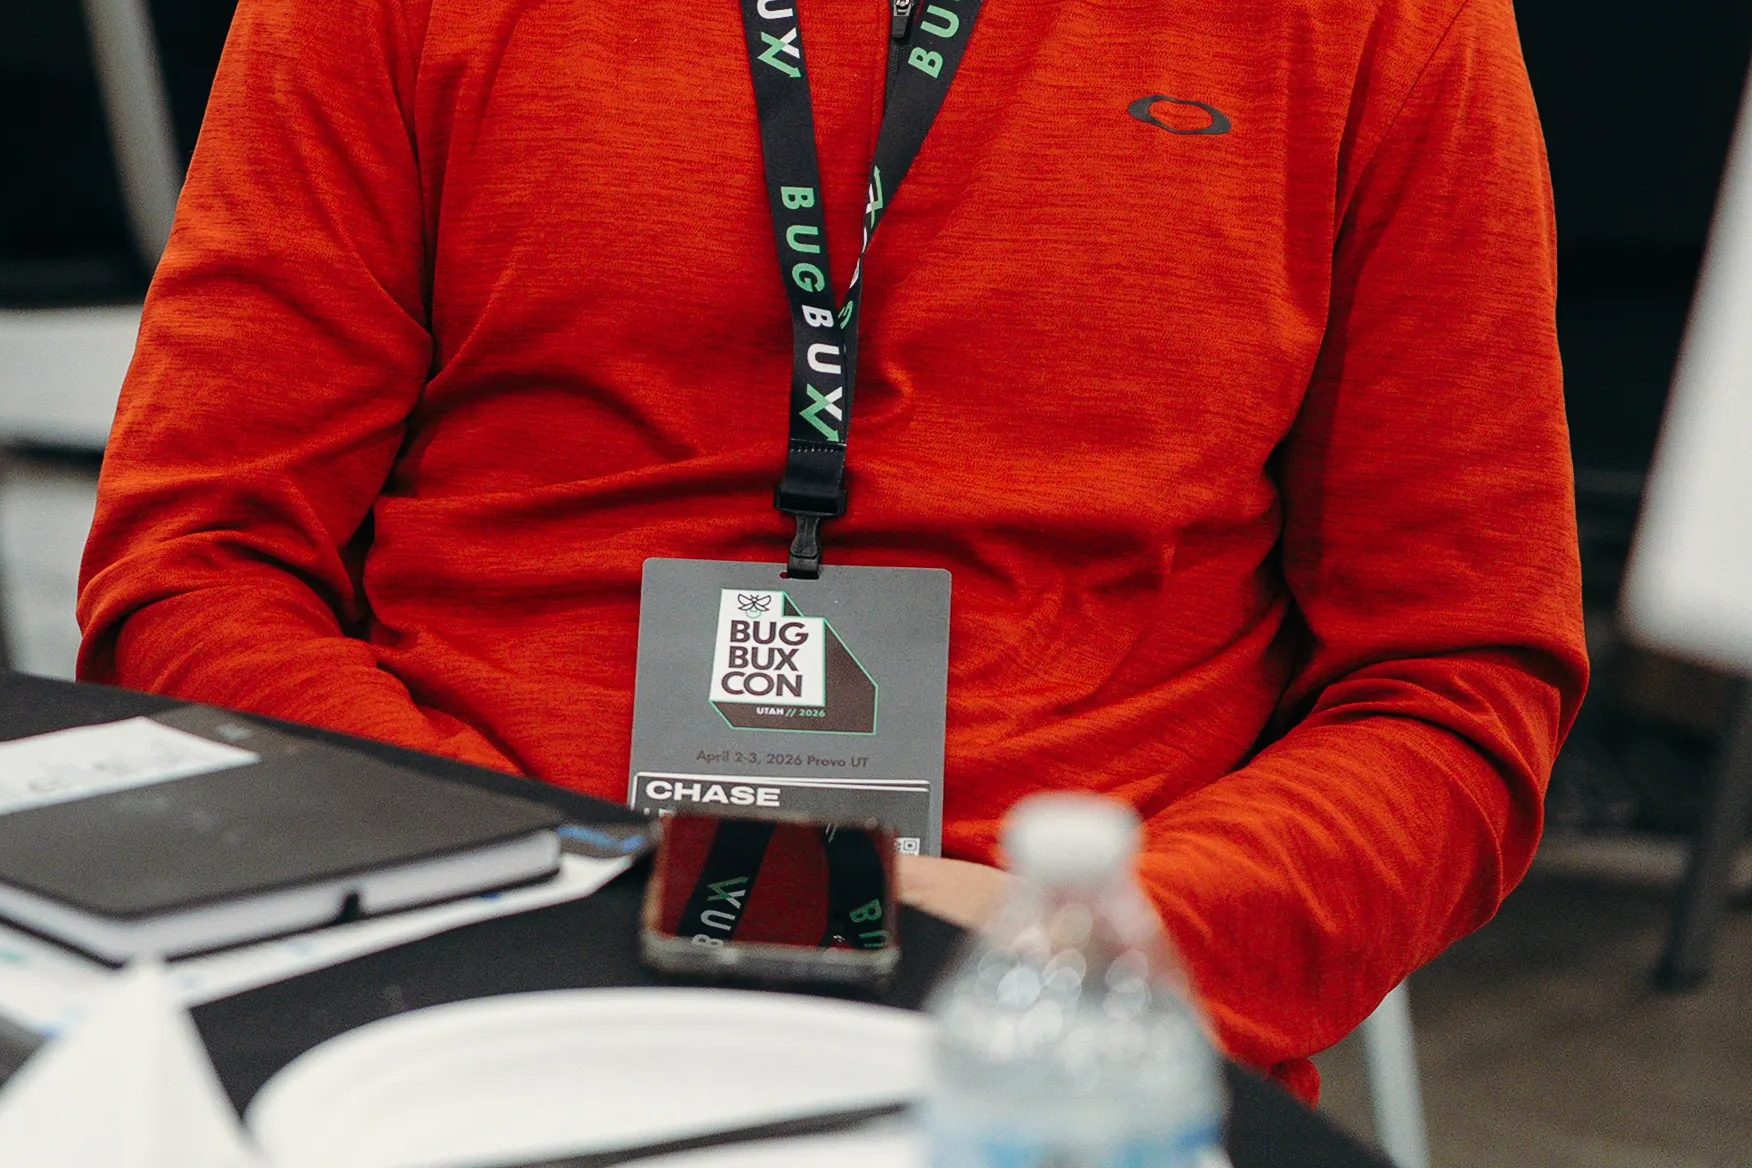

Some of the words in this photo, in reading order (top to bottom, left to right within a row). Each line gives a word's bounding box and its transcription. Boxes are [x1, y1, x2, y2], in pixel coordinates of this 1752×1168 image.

[730, 619, 809, 646] BUG
[728, 646, 800, 672] BUX
[721, 671, 803, 698] CON
[756, 706, 784, 717] UTAH
[798, 708, 826, 718] 2026
[696, 750, 730, 766] April
[734, 751, 762, 766] 2-3,
[766, 753, 803, 766] 2026
[807, 755, 847, 768] Provo
[850, 756, 870, 768] UT
[645, 780, 782, 807] CHASE
